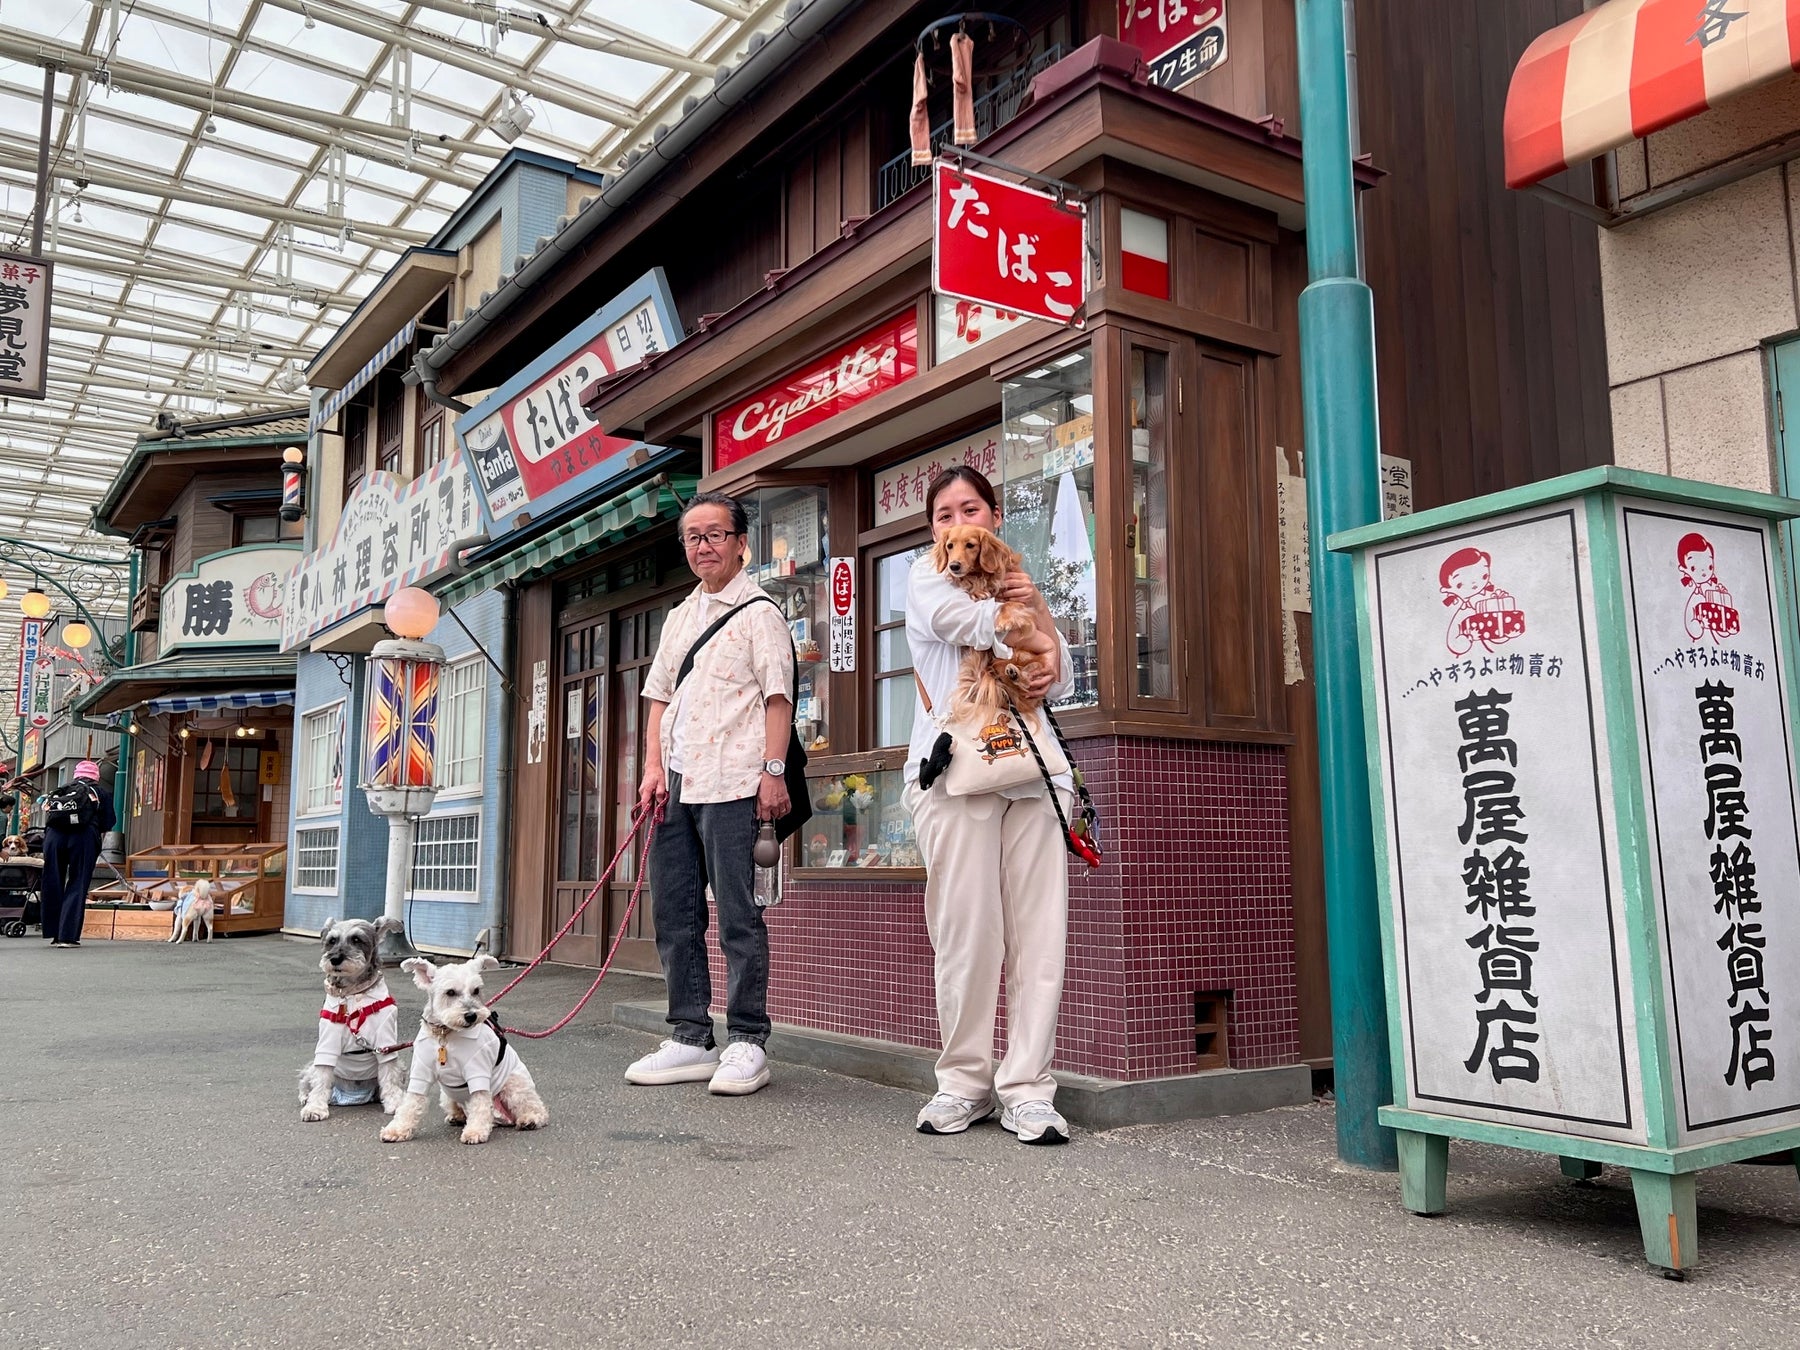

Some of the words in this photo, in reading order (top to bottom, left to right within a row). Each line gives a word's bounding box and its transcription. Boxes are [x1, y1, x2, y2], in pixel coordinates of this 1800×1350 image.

[2, 263, 41, 284] 菓子
[947, 182, 1076, 318] たばこ
[732, 343, 898, 442] Cigarettes
[478, 446, 514, 490] Fanta
[550, 433, 603, 480] やまとや
[1381, 466, 1410, 489] 堂
[311, 498, 430, 618] 小林理容所
[182, 580, 233, 636] 勝
[835, 567, 850, 611] たばこ
[843, 616, 854, 667] は現金で
[1454, 687, 1540, 1084] 萬屋雑貨店
[1695, 679, 1776, 1091] 萬屋雑貨店
